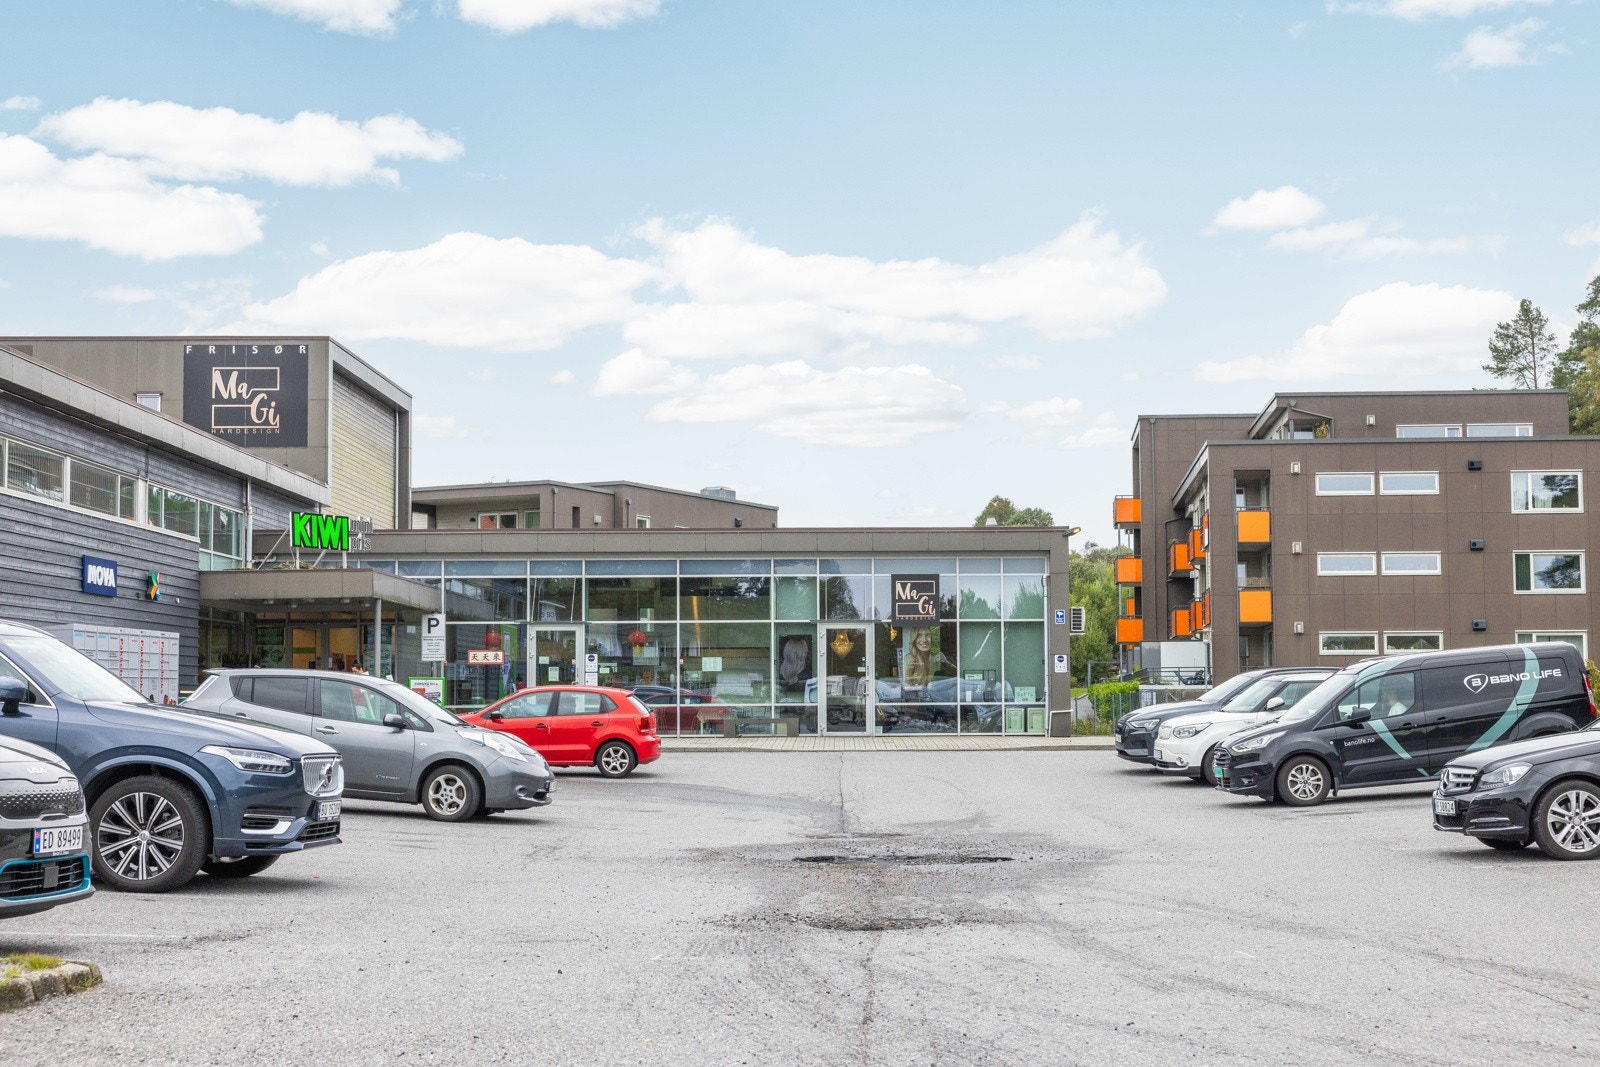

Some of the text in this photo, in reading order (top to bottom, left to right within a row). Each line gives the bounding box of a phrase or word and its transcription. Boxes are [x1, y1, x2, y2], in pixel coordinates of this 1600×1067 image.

[186, 345, 306, 354] FRISØR
[212, 370, 250, 399] Ma
[250, 393, 280, 425] Gi
[292, 512, 349, 551] KIWI
[896, 582, 919, 600] Ma
[918, 596, 936, 615] Gi
[427, 617, 440, 634] P
[1532, 668, 1563, 679] LIFE
[1343, 737, 1376, 747] banolife.no
[42, 828, 81, 850] ED 89499
